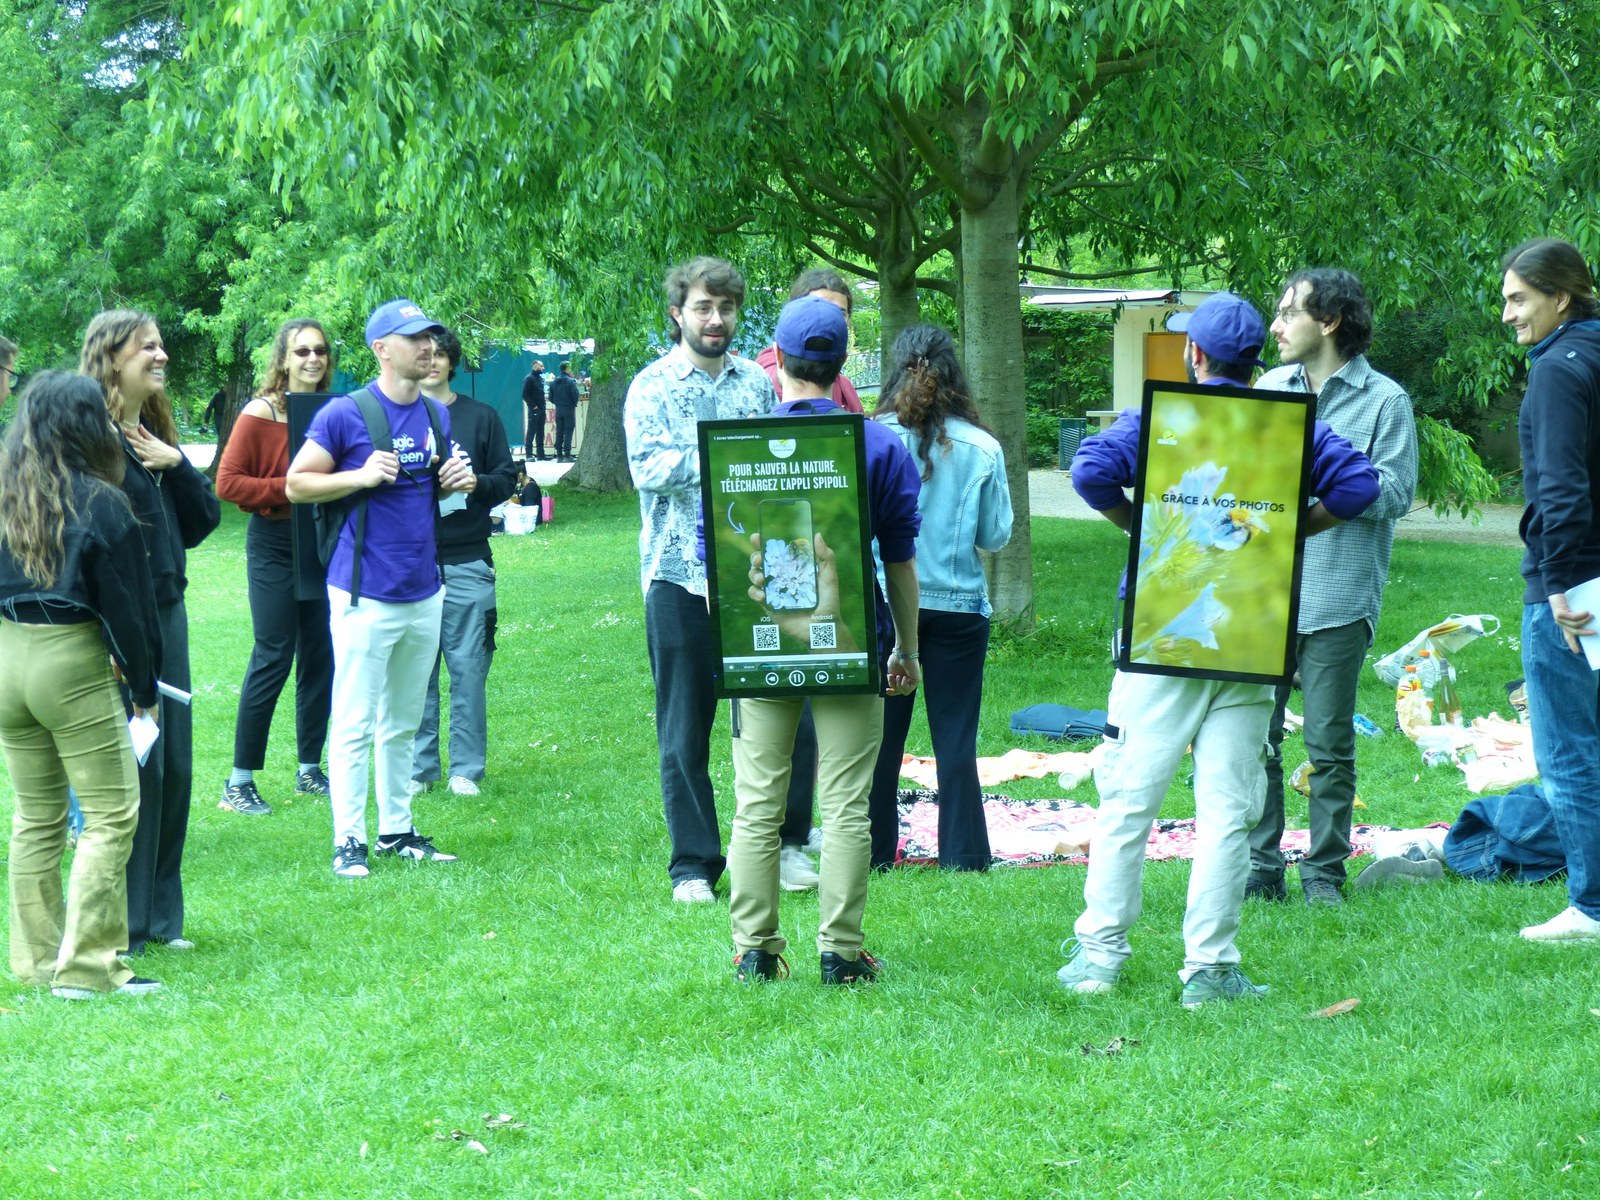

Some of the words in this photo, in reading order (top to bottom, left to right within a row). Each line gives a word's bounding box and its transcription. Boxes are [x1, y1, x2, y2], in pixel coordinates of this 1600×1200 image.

[392, 433, 415, 450] agic
[397, 451, 424, 463] reen
[729, 463, 753, 477] POUR
[755, 462, 787, 476] SAUVER
[790, 462, 801, 475] LA
[802, 460, 838, 474] NATURE,
[720, 478, 778, 493] TÉLÉCHARGEZ
[813, 475, 849, 489] SPIPOLL
[1161, 493, 1199, 505] GRÂCE
[1201, 494, 1210, 506] À
[1213, 498, 1236, 509] VOS
[1239, 500, 1285, 513] PHOTOS
